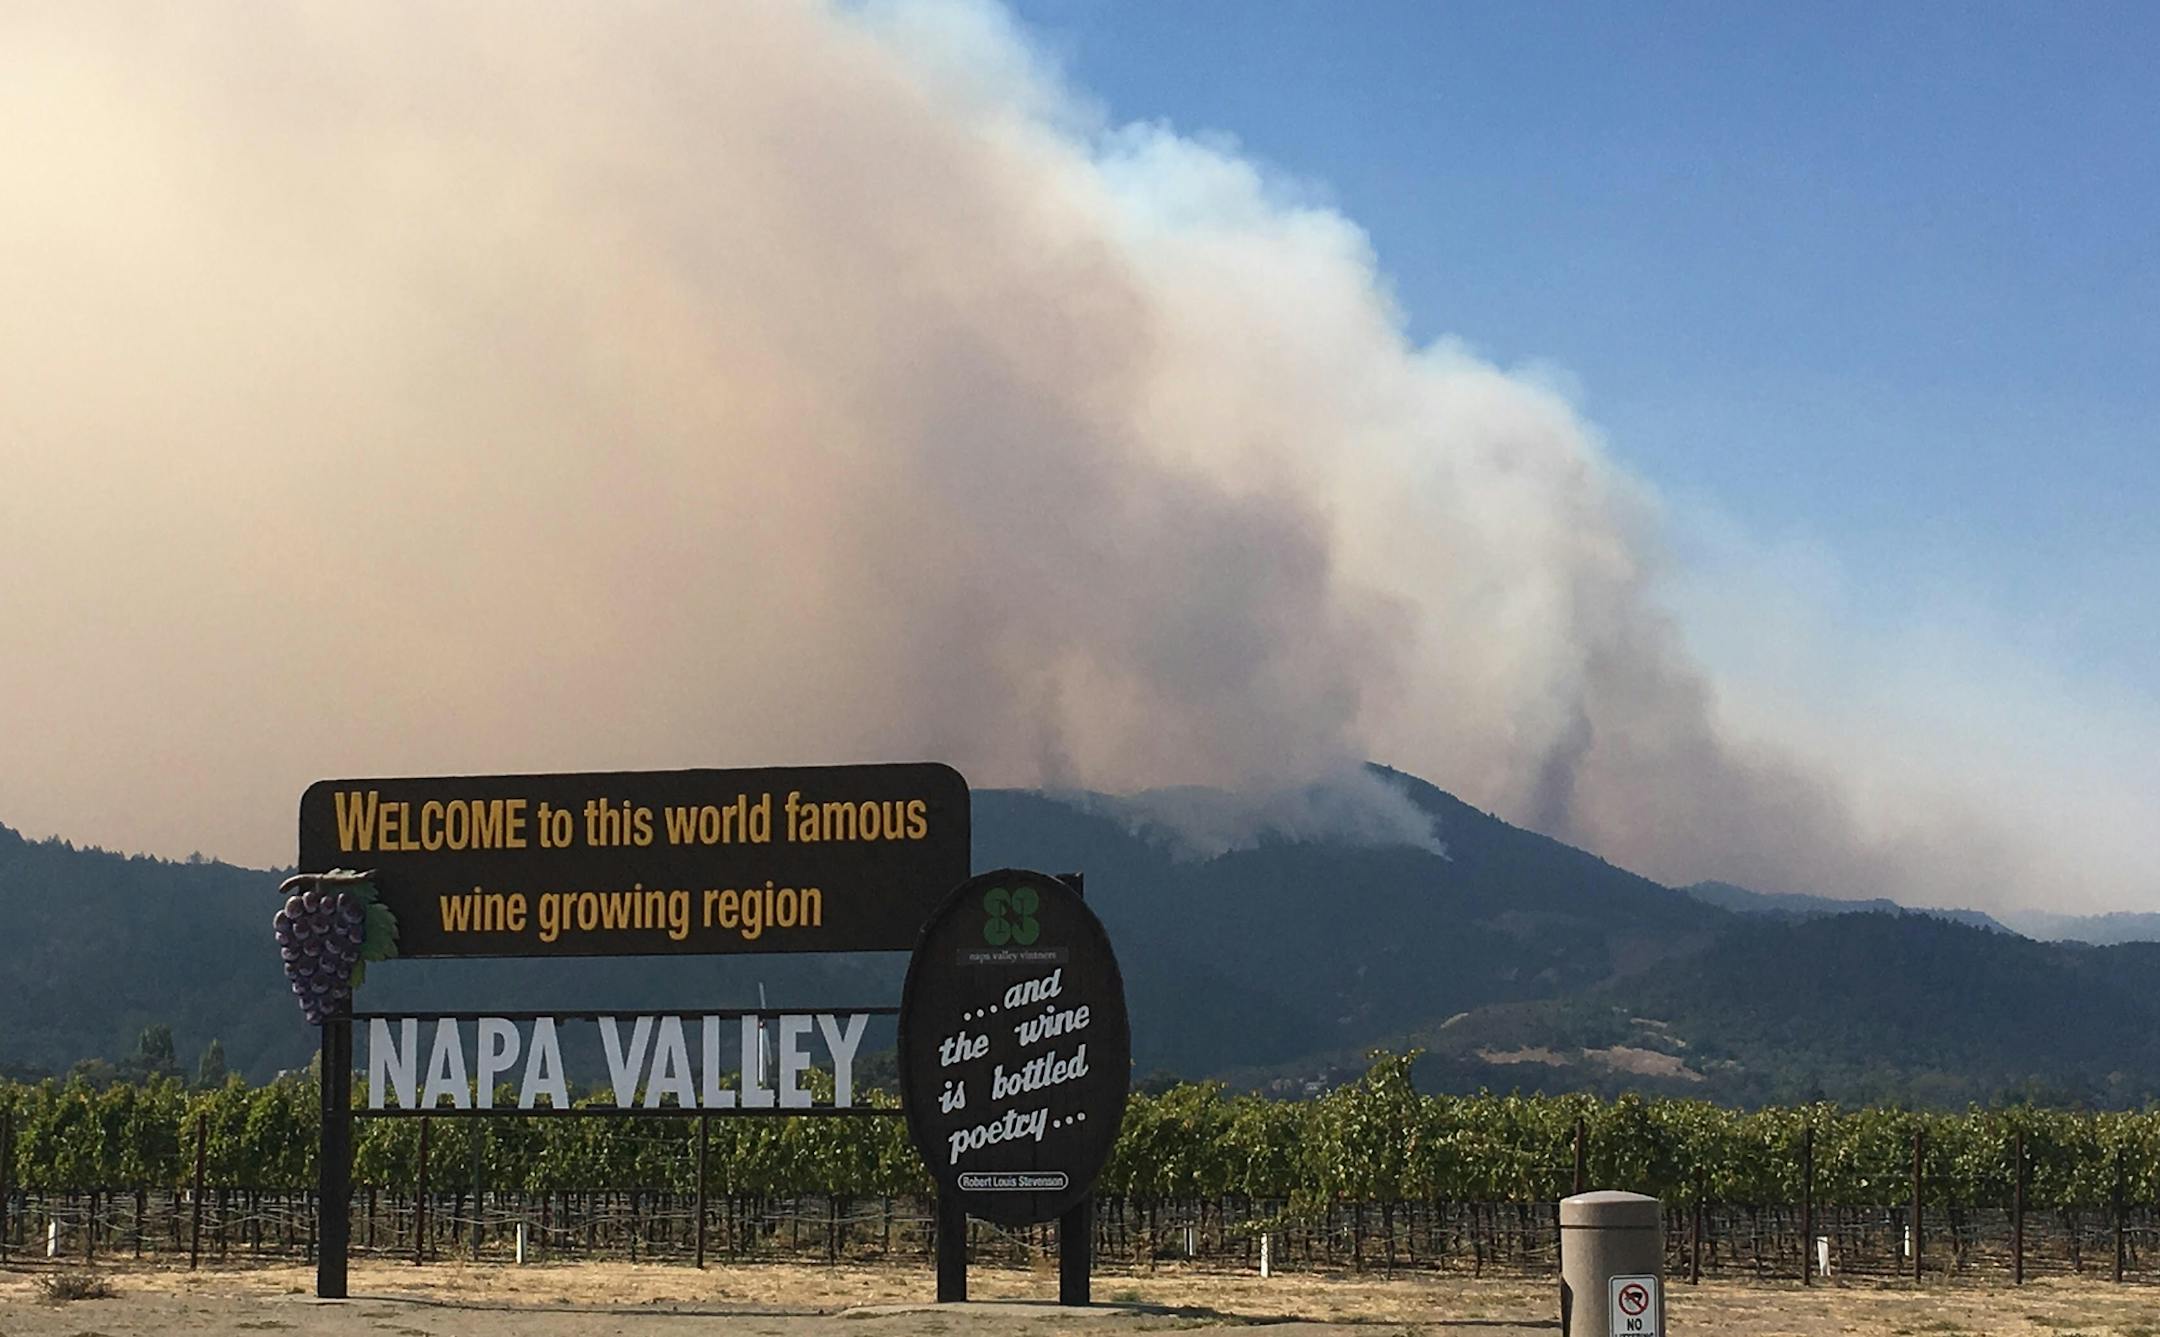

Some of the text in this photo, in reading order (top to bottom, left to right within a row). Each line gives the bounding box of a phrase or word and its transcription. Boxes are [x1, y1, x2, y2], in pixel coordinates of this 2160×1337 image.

[334, 790, 927, 852] WELCOME to this world famous
[440, 880, 822, 942] wine growing region
[968, 950, 1057, 964] napa valley vintners
[368, 1013, 870, 1110] NAPA VALLEY
[938, 1005, 1090, 1067] the wine
[938, 1044, 1089, 1114] is bottled
[962, 1175, 1064, 1187] Robert Louis Stevenson
[1627, 1318, 1642, 1331] NO
